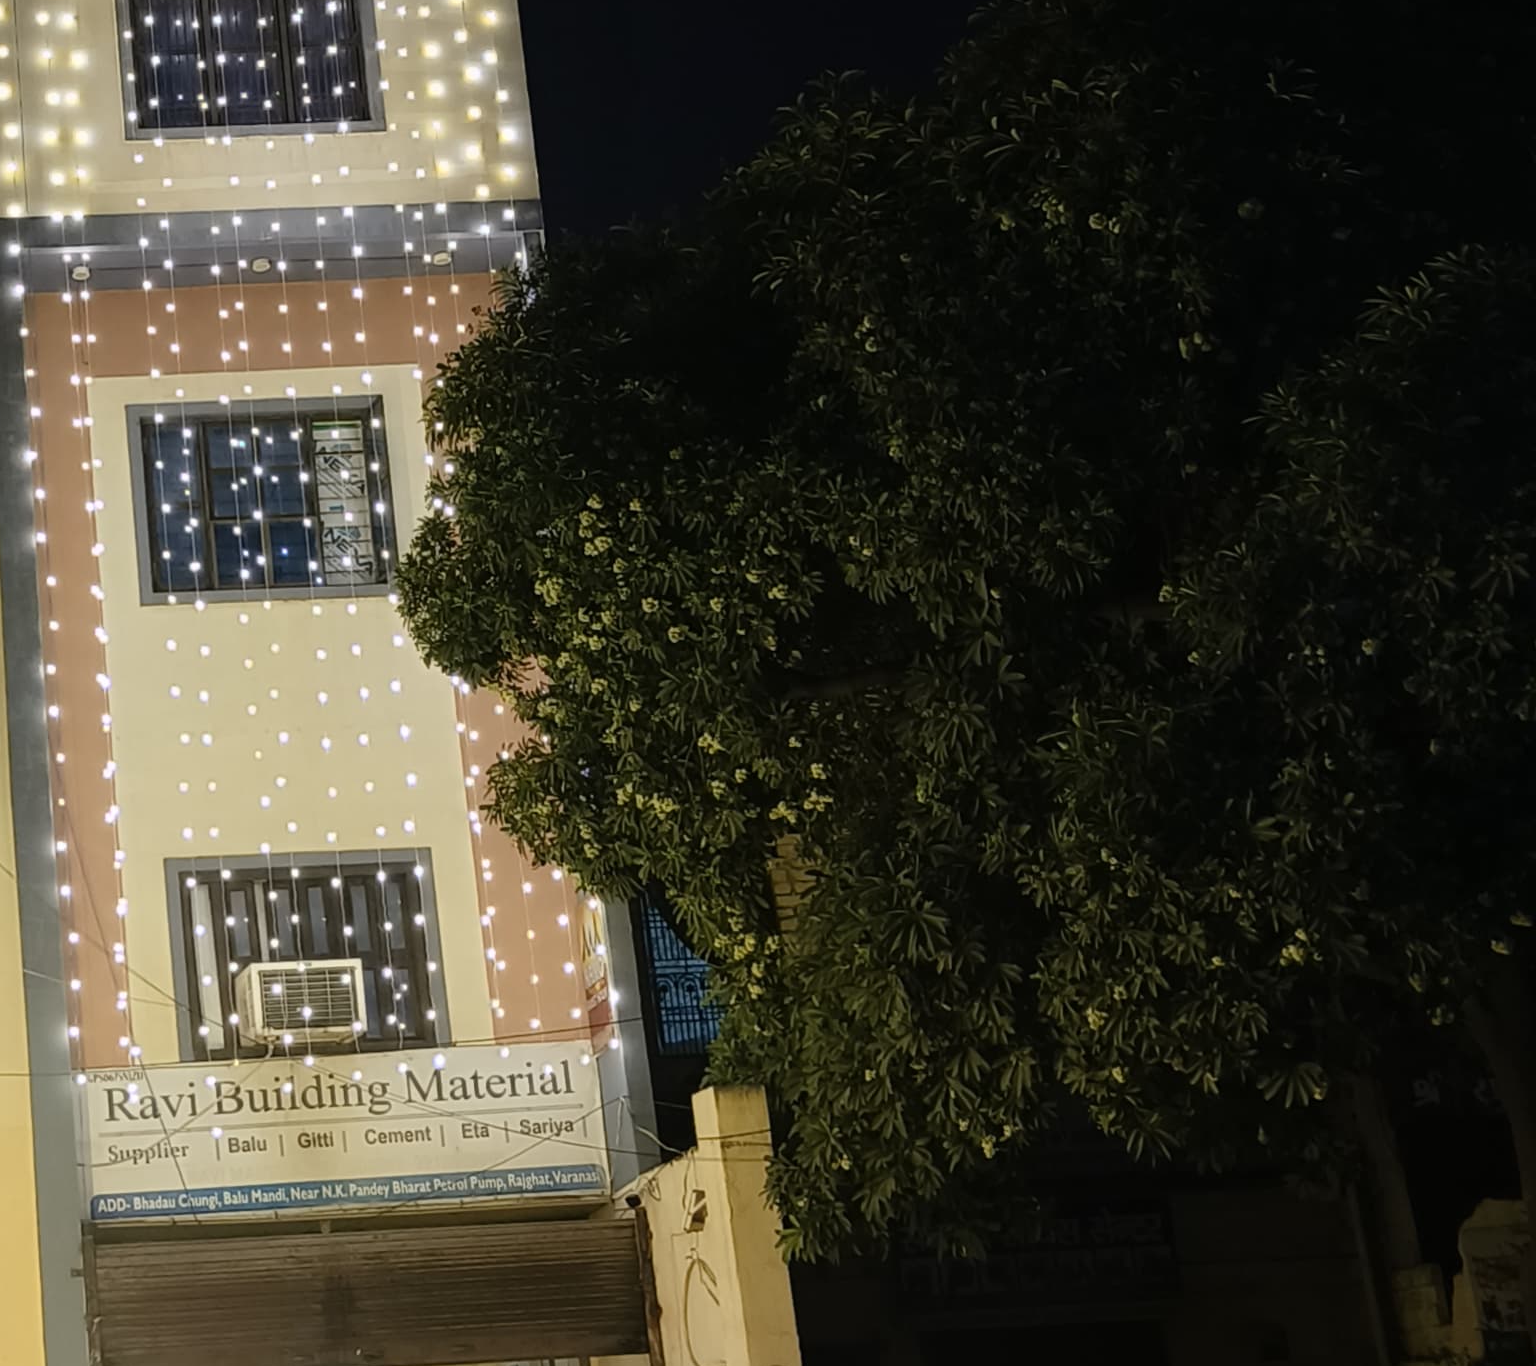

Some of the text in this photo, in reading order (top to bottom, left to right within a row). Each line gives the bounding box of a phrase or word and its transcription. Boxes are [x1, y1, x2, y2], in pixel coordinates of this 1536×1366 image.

[104, 1059, 575, 1123] Ravi Building Material
[107, 1117, 574, 1165] Supplier Balu Gitti Cement Eta Sariya
[98, 1197, 131, 1213] ADD-
[133, 1194, 176, 1211] Bhadau
[178, 1192, 222, 1211] Chungi,
[223, 1190, 249, 1205] Balu
[251, 1188, 289, 1203] Mandi,
[291, 1186, 320, 1201] Near
[322, 1183, 347, 1198] N.K.
[349, 1182, 389, 1199] Pandey
[393, 1180, 431, 1195] Bharat
[434, 1177, 468, 1192] Petrol
[470, 1175, 507, 1191] Pump,
[508, 1172, 553, 1190] Rajghat,
